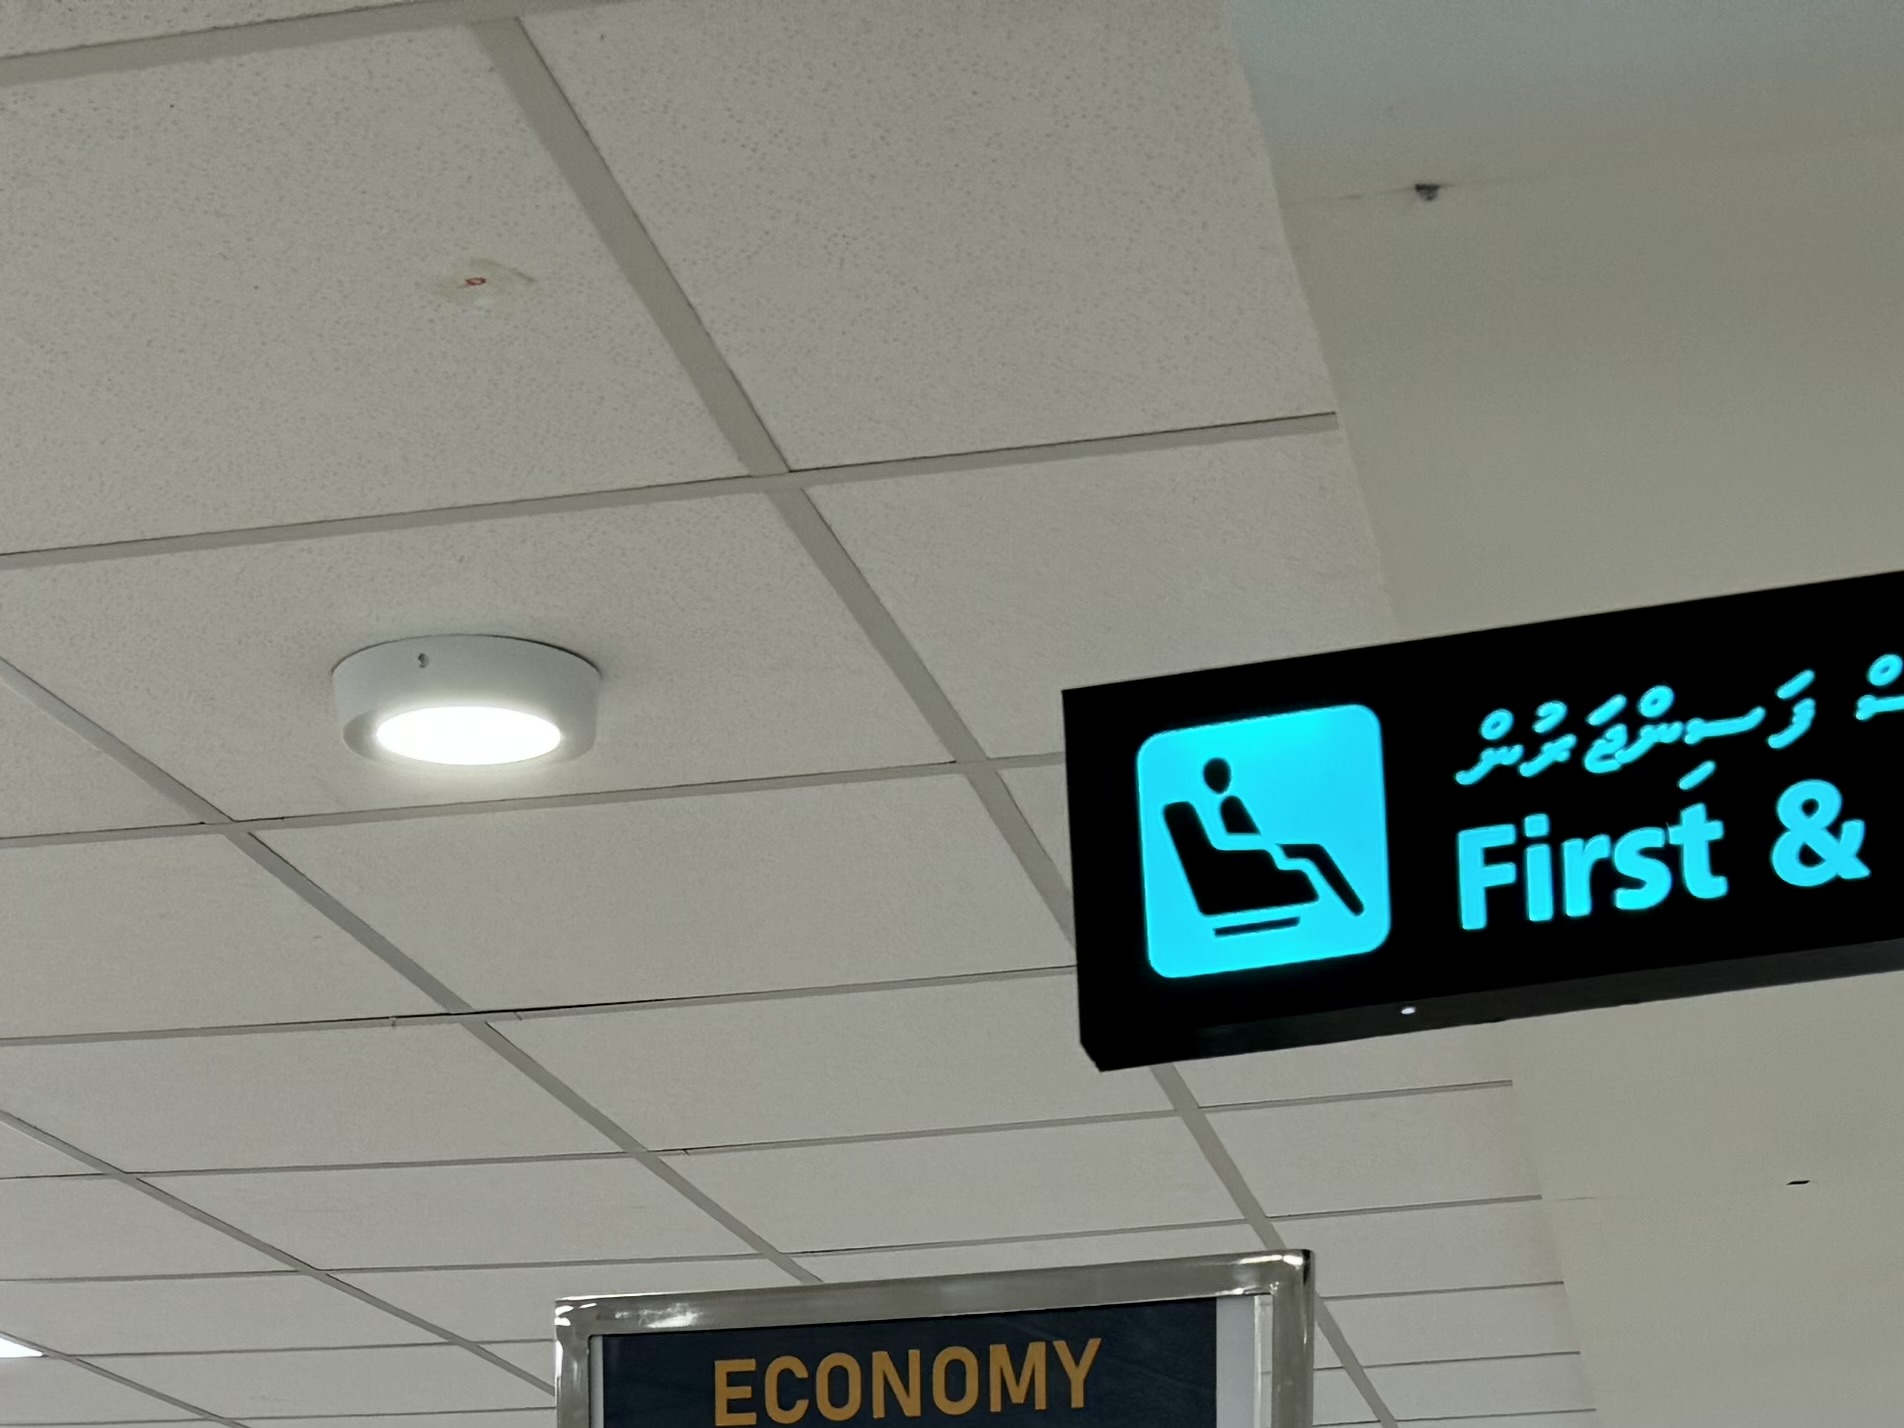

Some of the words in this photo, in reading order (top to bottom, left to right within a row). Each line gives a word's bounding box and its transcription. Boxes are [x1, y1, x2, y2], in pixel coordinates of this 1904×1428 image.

[1456, 802, 1729, 931] First
[1770, 779, 1871, 888] &
[715, 1338, 1102, 1427] ECONOMY
